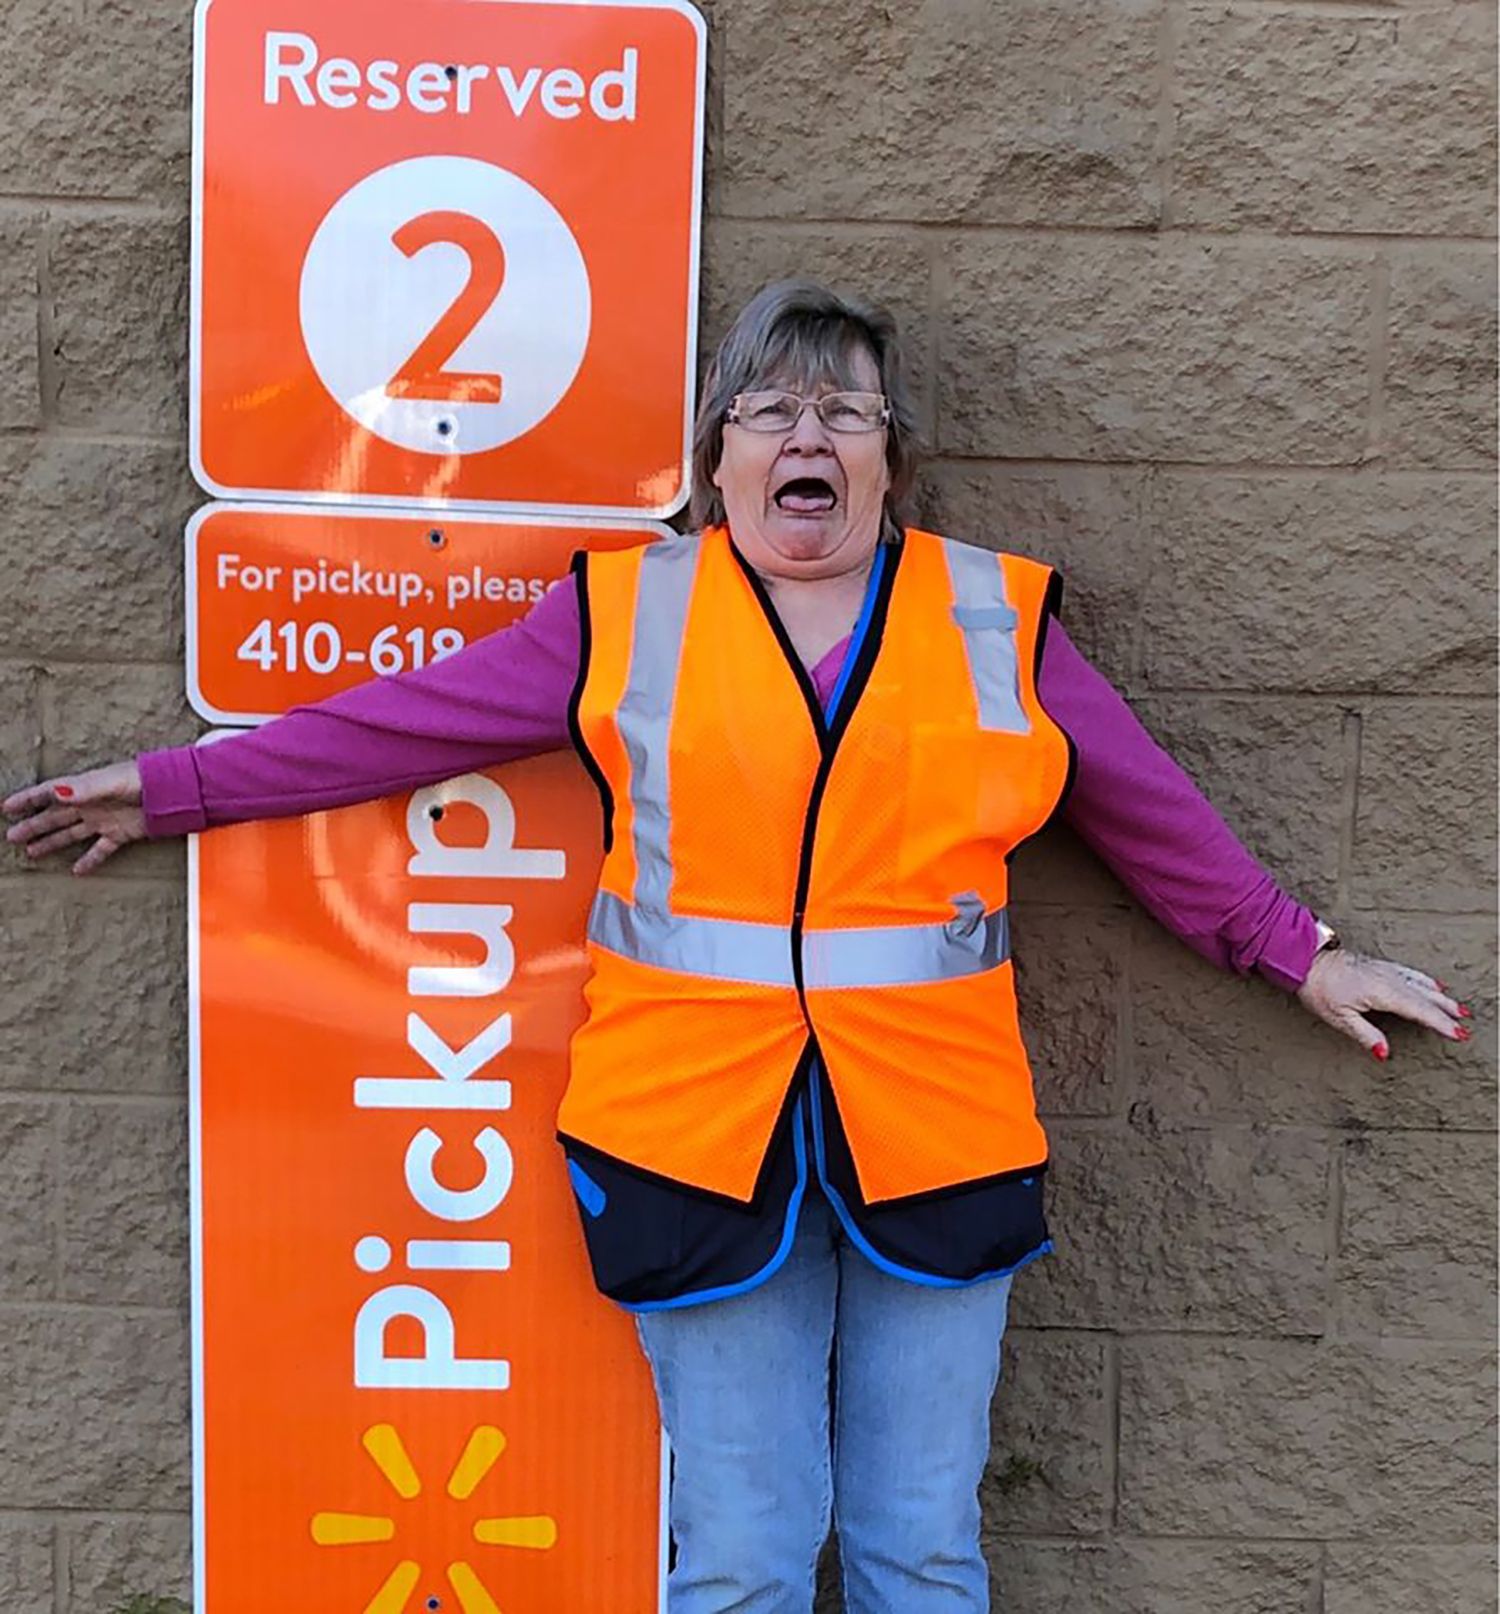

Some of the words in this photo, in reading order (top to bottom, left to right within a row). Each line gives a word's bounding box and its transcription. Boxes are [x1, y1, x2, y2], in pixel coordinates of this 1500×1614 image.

[264, 31, 638, 121] Reserved
[385, 210, 506, 404] 2
[217, 553, 282, 591] For
[292, 558, 435, 608] pickup,
[447, 565, 562, 610] pleas
[353, 772, 566, 1390] Pickup
